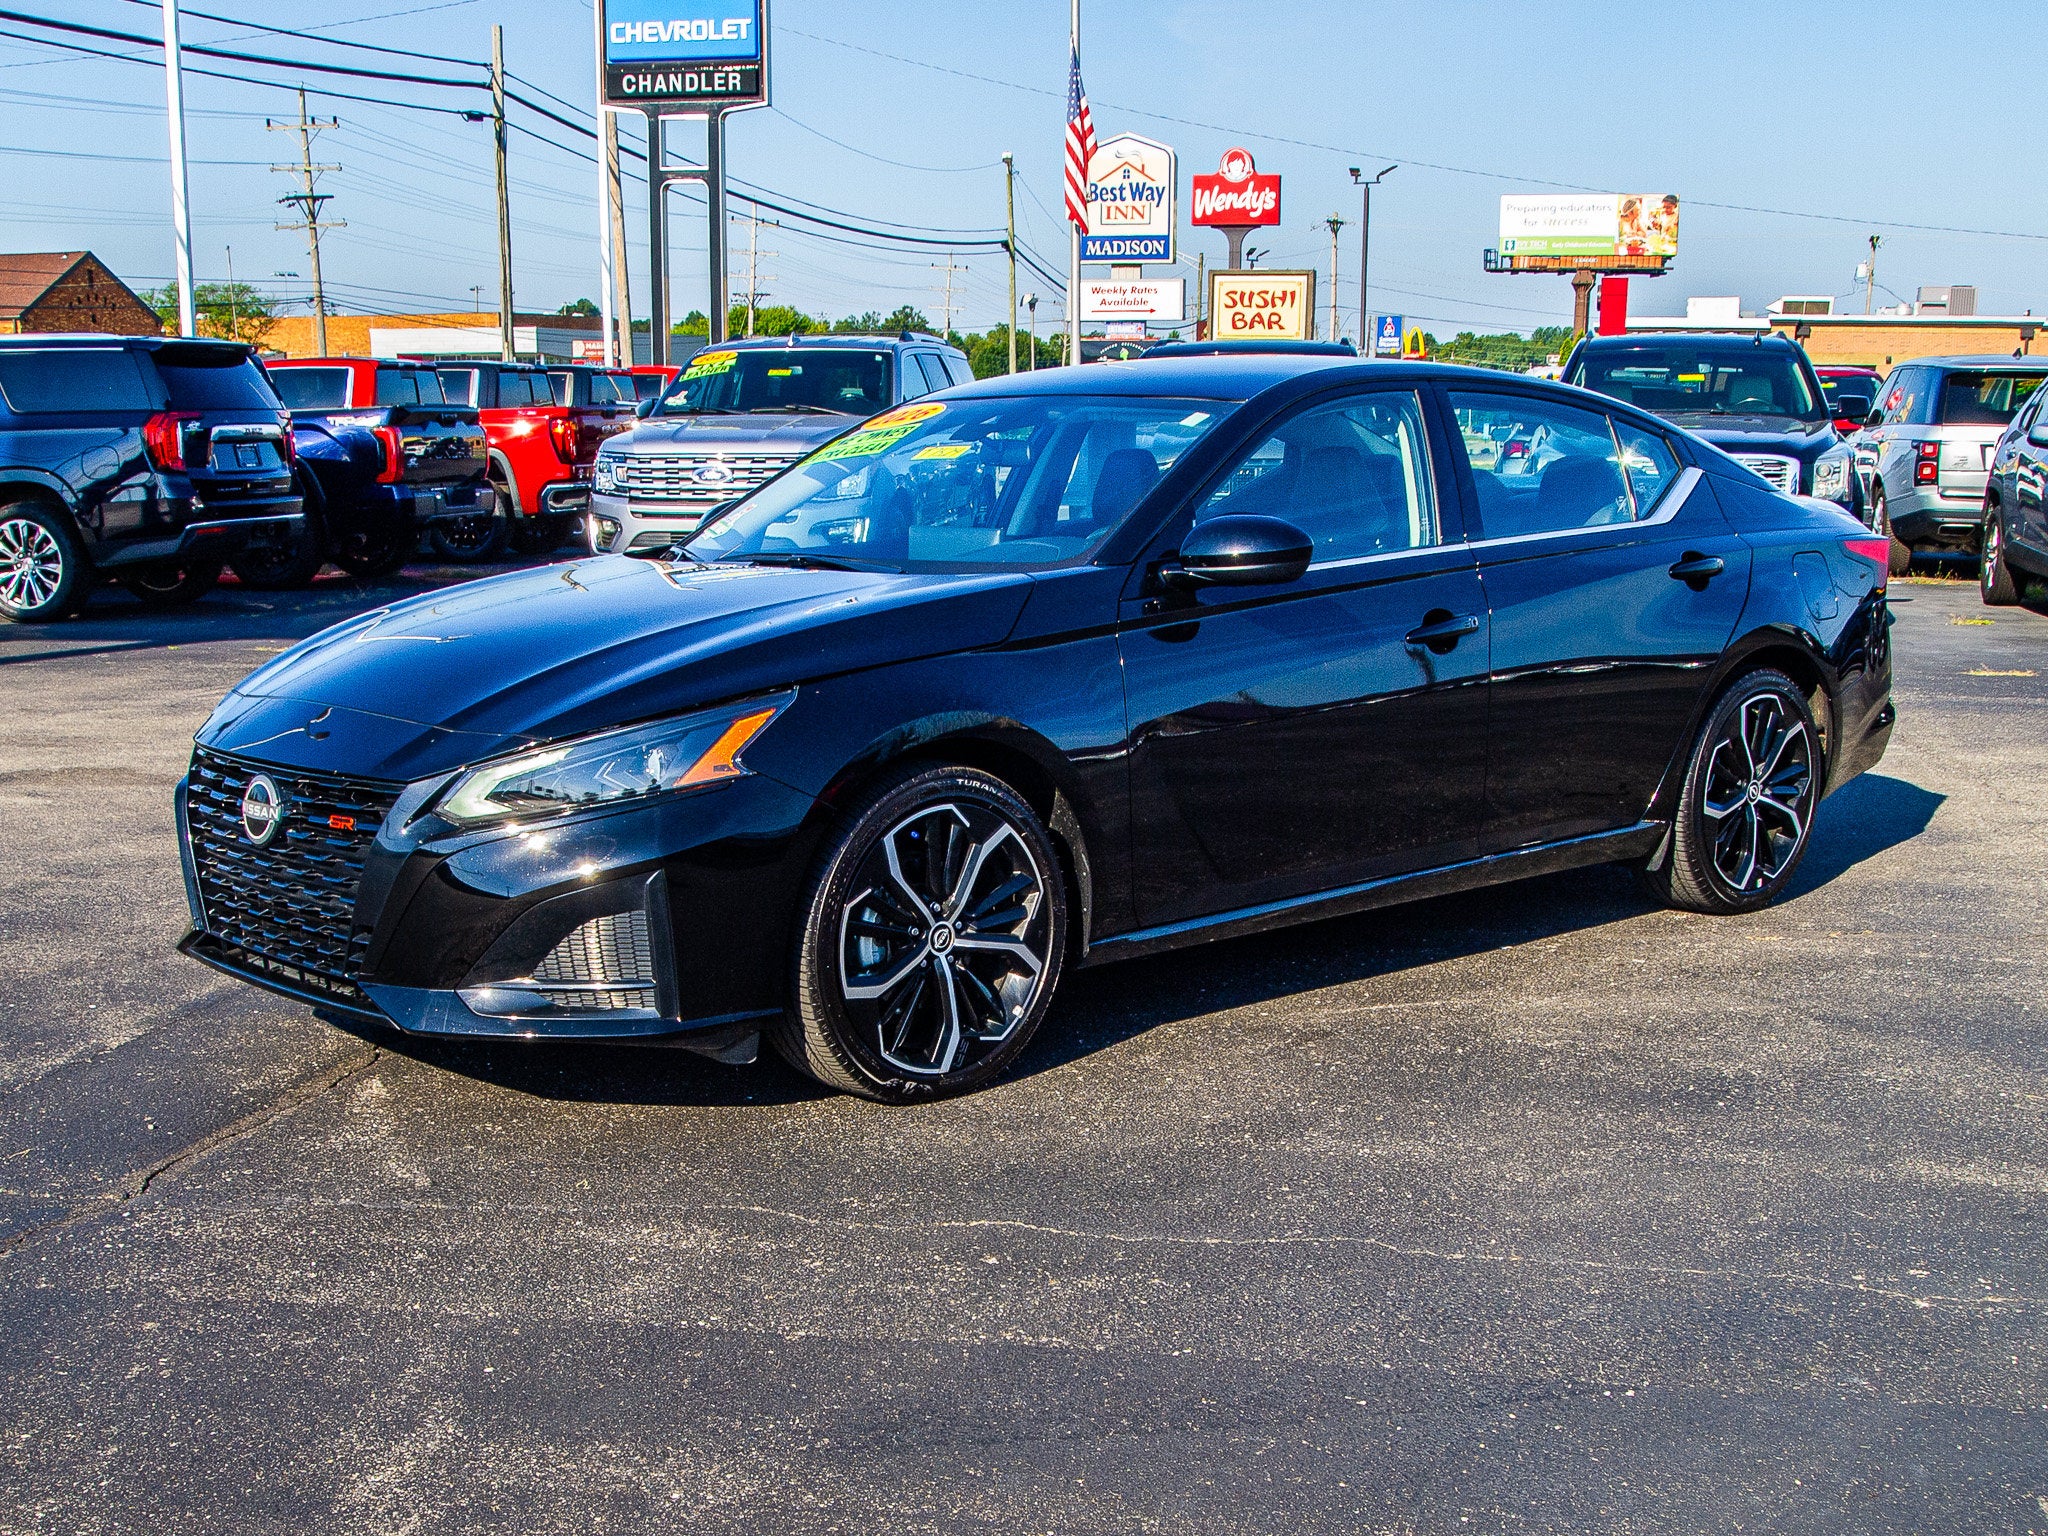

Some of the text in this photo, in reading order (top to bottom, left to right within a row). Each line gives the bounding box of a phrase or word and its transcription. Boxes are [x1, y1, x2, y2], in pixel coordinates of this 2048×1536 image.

[610, 18, 752, 44] CHEVROLET
[622, 72, 741, 94] CHANDLER
[1090, 182, 1166, 208] Best Way
[1195, 181, 1276, 218] Wendy's
[1106, 205, 1145, 220] INN
[1506, 203, 1612, 214] Preparing educators
[1086, 240, 1165, 256] MADISON
[1091, 286, 1157, 296] Weekly Rates
[1224, 290, 1296, 309] SUSHI
[1100, 298, 1148, 306] Available
[1231, 311, 1285, 330] BAR
[956, 778, 1005, 799] TURANZ
[330, 815, 354, 831] SR
